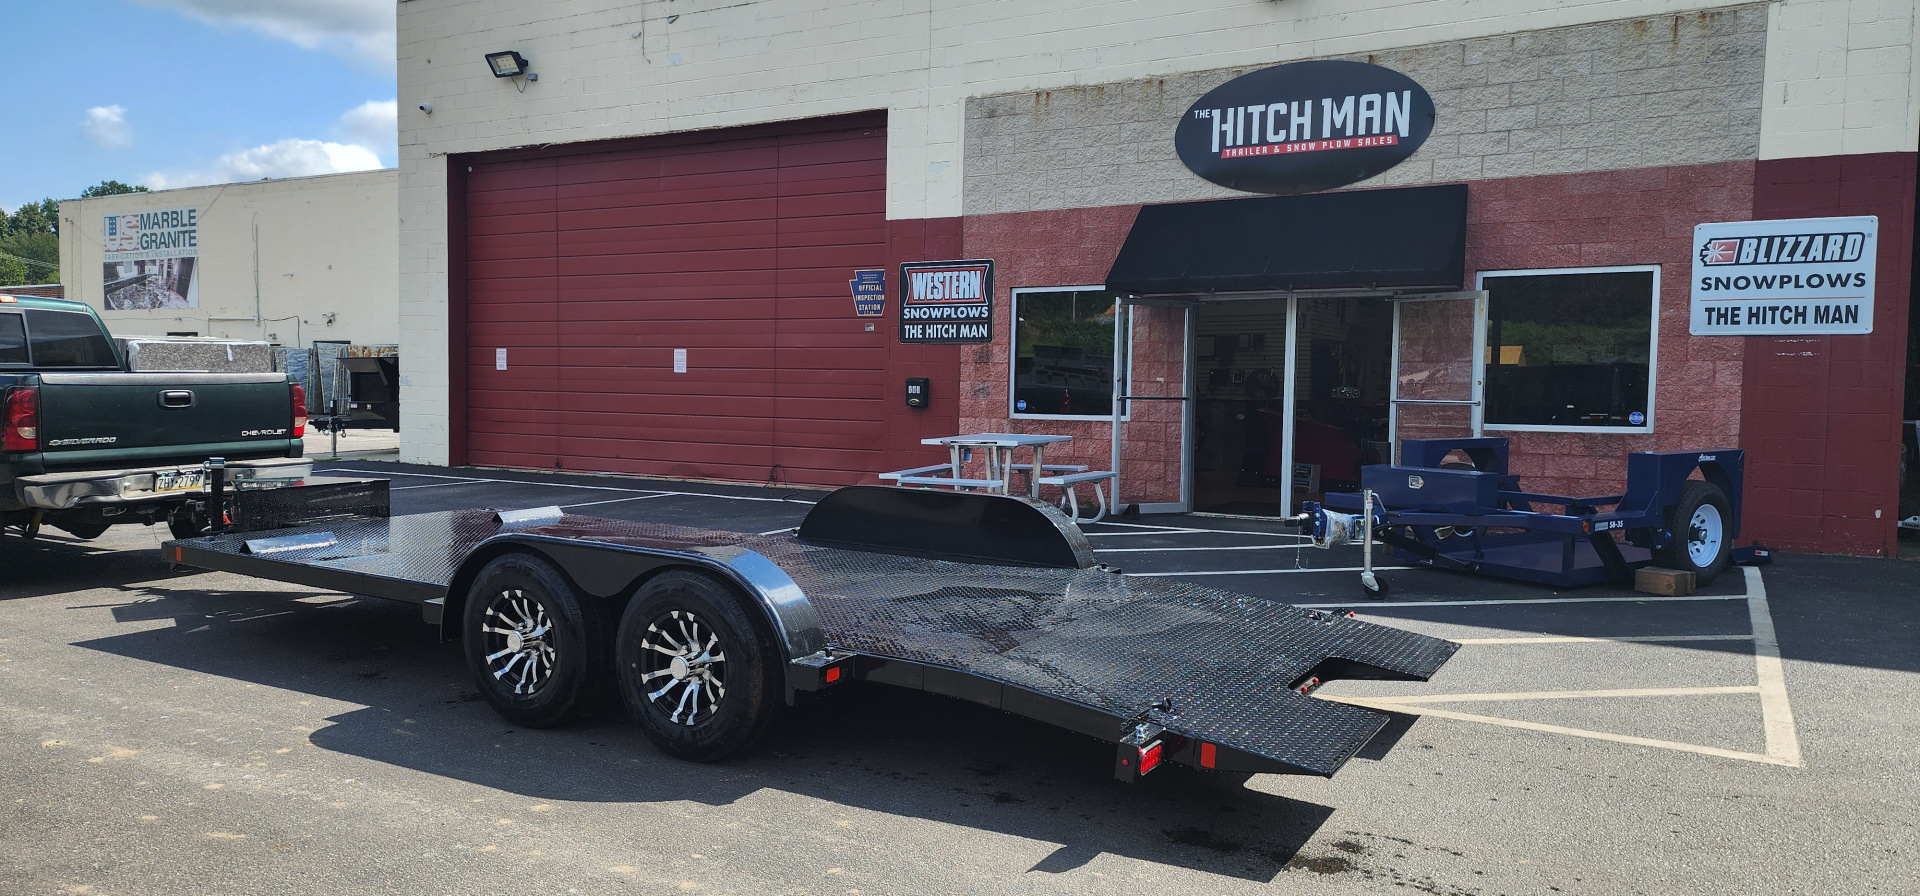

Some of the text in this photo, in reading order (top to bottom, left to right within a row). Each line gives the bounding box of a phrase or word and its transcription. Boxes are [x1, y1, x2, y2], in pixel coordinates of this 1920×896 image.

[1194, 90, 1412, 153] THE HITCH MAN
[1225, 136, 1393, 157] TRAILER & SNOW PLOW SALES
[140, 209, 197, 230] MARBLE
[140, 230, 197, 250] GRANITE
[1739, 233, 1863, 264] BLIZZARD
[104, 252, 144, 261] FABRICATION
[152, 248, 198, 258] INSTALLATION
[858, 284, 883, 292] OFFICIAL
[911, 270, 981, 300] WESTERN
[1700, 272, 1866, 291] SNOWPLOWS
[858, 303, 881, 311] STATION
[903, 306, 989, 319] SNOWPLOWS
[1704, 304, 1859, 325] THE HITCH MAN
[904, 324, 988, 338] THE HITCH MAN
[61, 437, 117, 446] SILVERADO
[241, 429, 287, 437] CHEVROLET
